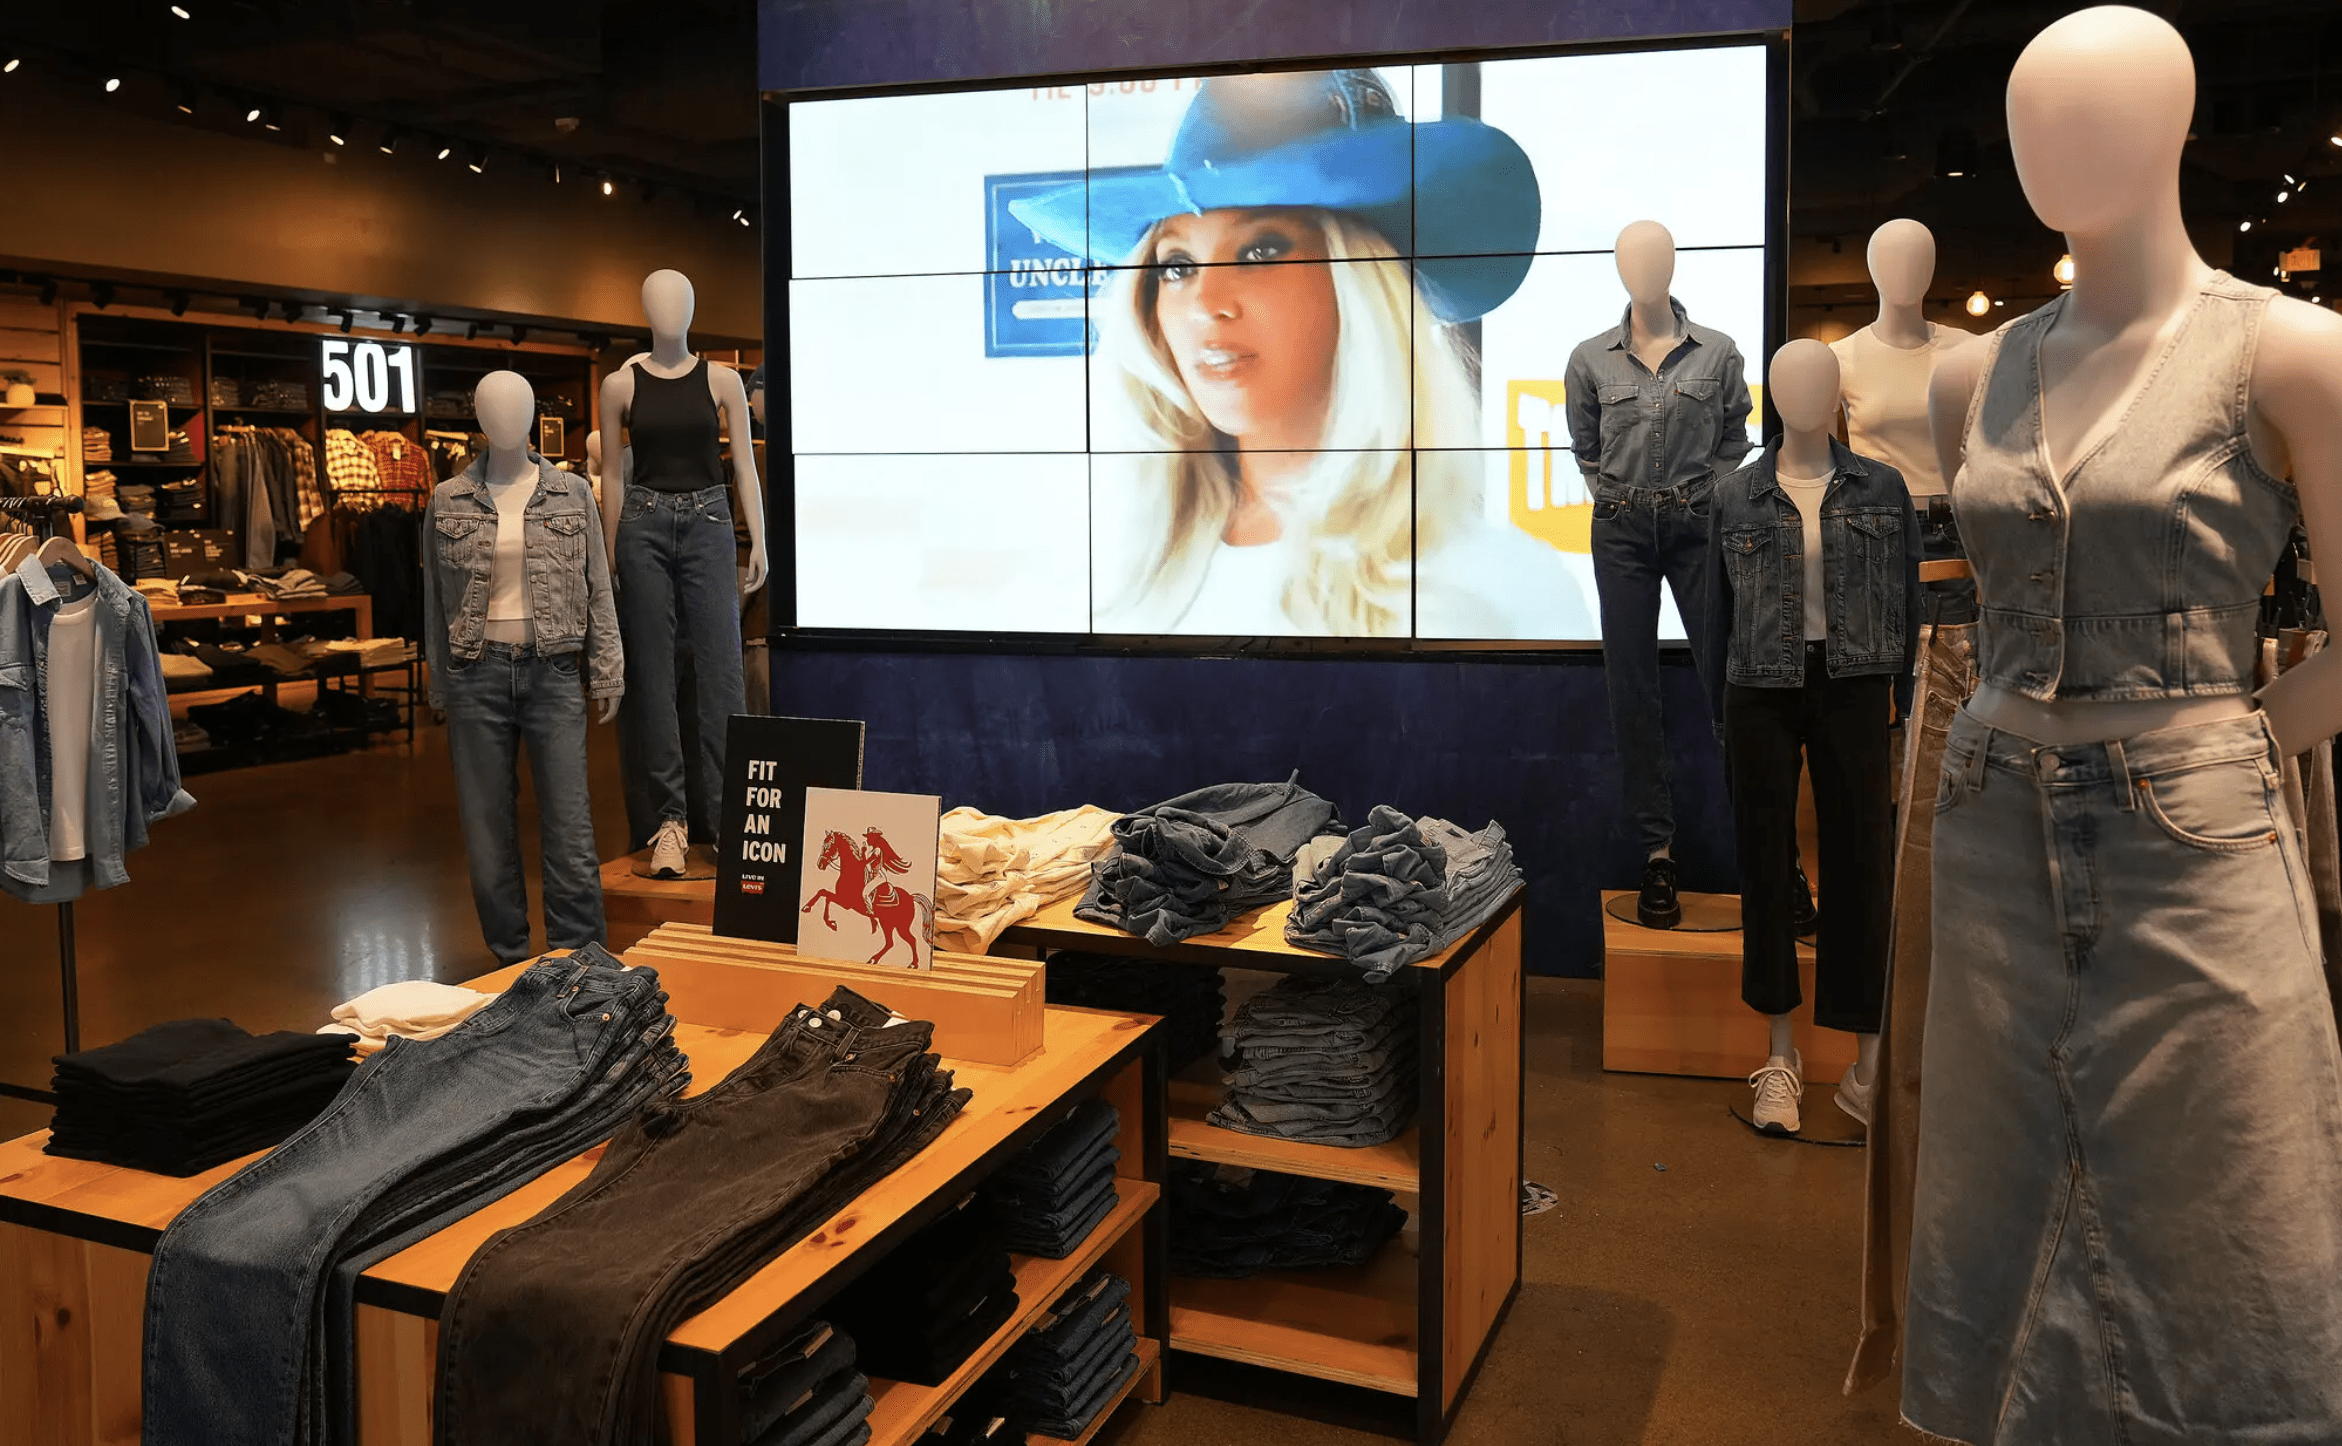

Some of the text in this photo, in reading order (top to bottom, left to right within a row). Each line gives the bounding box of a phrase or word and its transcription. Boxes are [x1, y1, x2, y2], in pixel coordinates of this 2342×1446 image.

[322, 340, 416, 413] 501
[748, 760, 777, 781] FIT
[746, 786, 782, 809] FOR
[744, 814, 770, 835] AN
[742, 840, 786, 864] ICON
